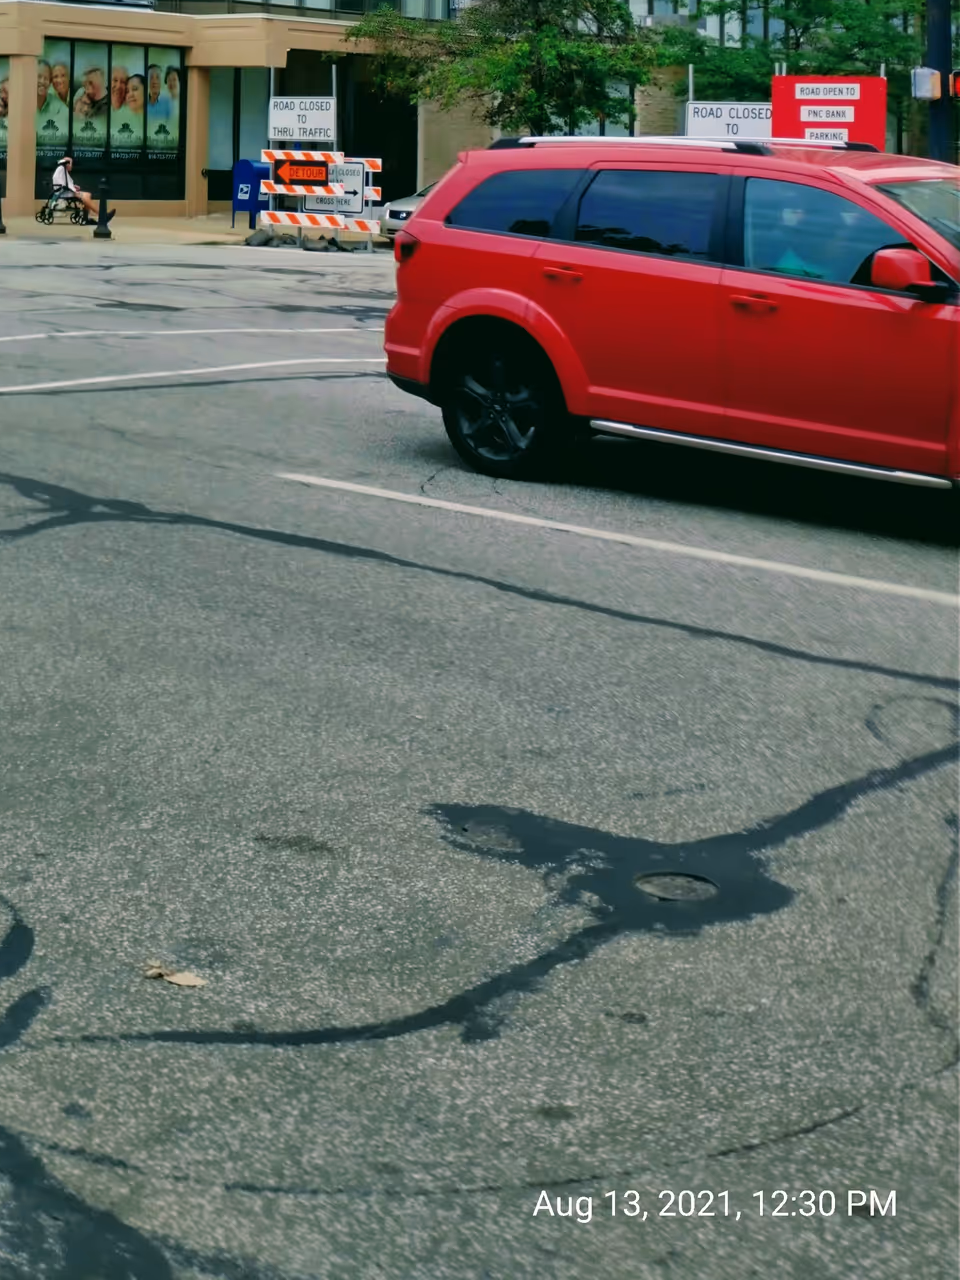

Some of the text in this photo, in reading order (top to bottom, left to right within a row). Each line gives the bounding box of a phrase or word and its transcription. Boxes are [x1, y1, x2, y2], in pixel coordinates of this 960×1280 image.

[800, 86, 856, 96] ROAD OPEN TO
[273, 101, 331, 111] ROAD CLOSED
[296, 114, 308, 124] TO
[693, 108, 772, 120] ROAD CLOSED
[807, 109, 847, 119] PNC BANK
[272, 127, 332, 138] THRU TRAFFIC
[725, 123, 739, 135] TO
[809, 132, 844, 141] PARKING
[289, 167, 325, 178] DETOUR
[338, 169, 361, 177] CLOSED
[316, 197, 335, 205] CROSS
